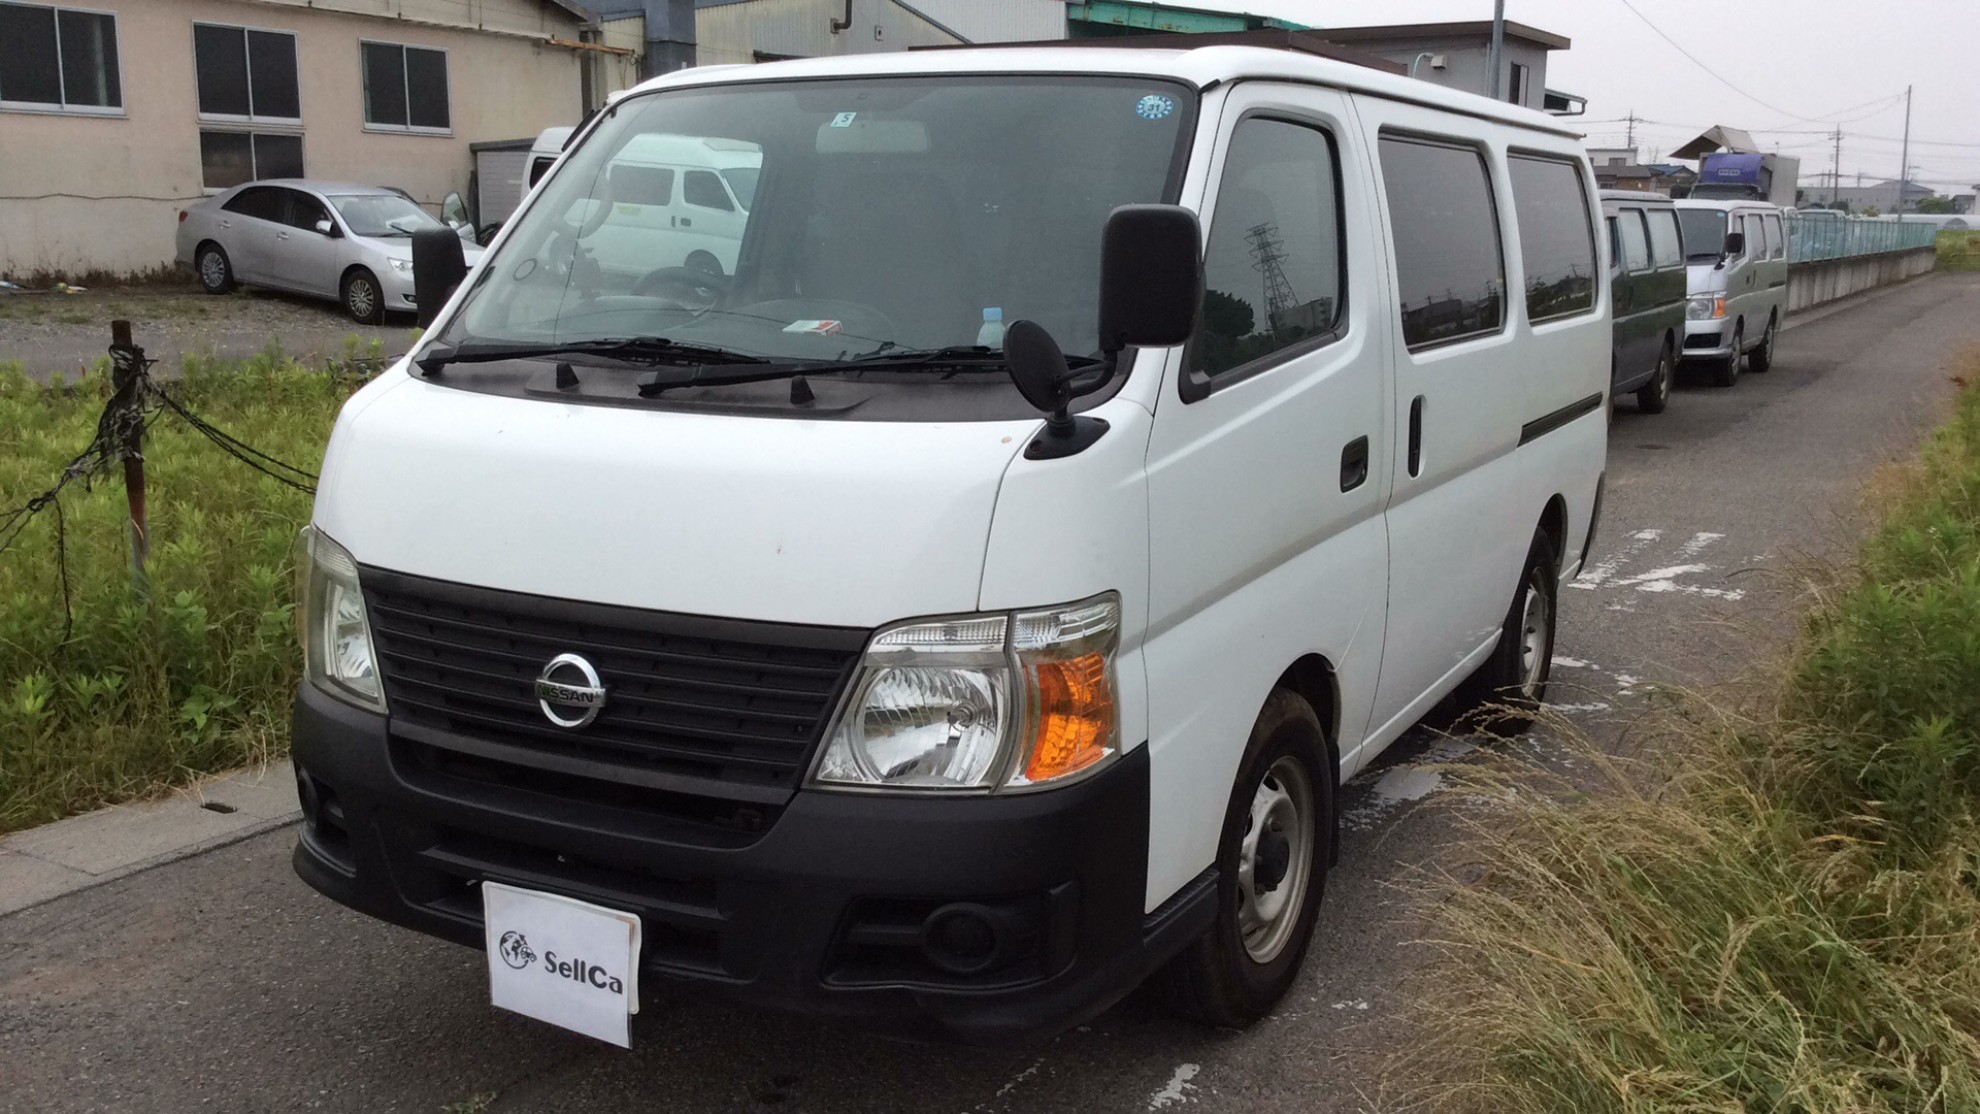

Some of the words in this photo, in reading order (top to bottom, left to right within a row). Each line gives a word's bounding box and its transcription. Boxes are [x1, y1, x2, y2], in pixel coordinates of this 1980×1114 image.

[841, 113, 852, 123] 5
[538, 684, 594, 703] NISSAN
[544, 950, 623, 995] SellCa
